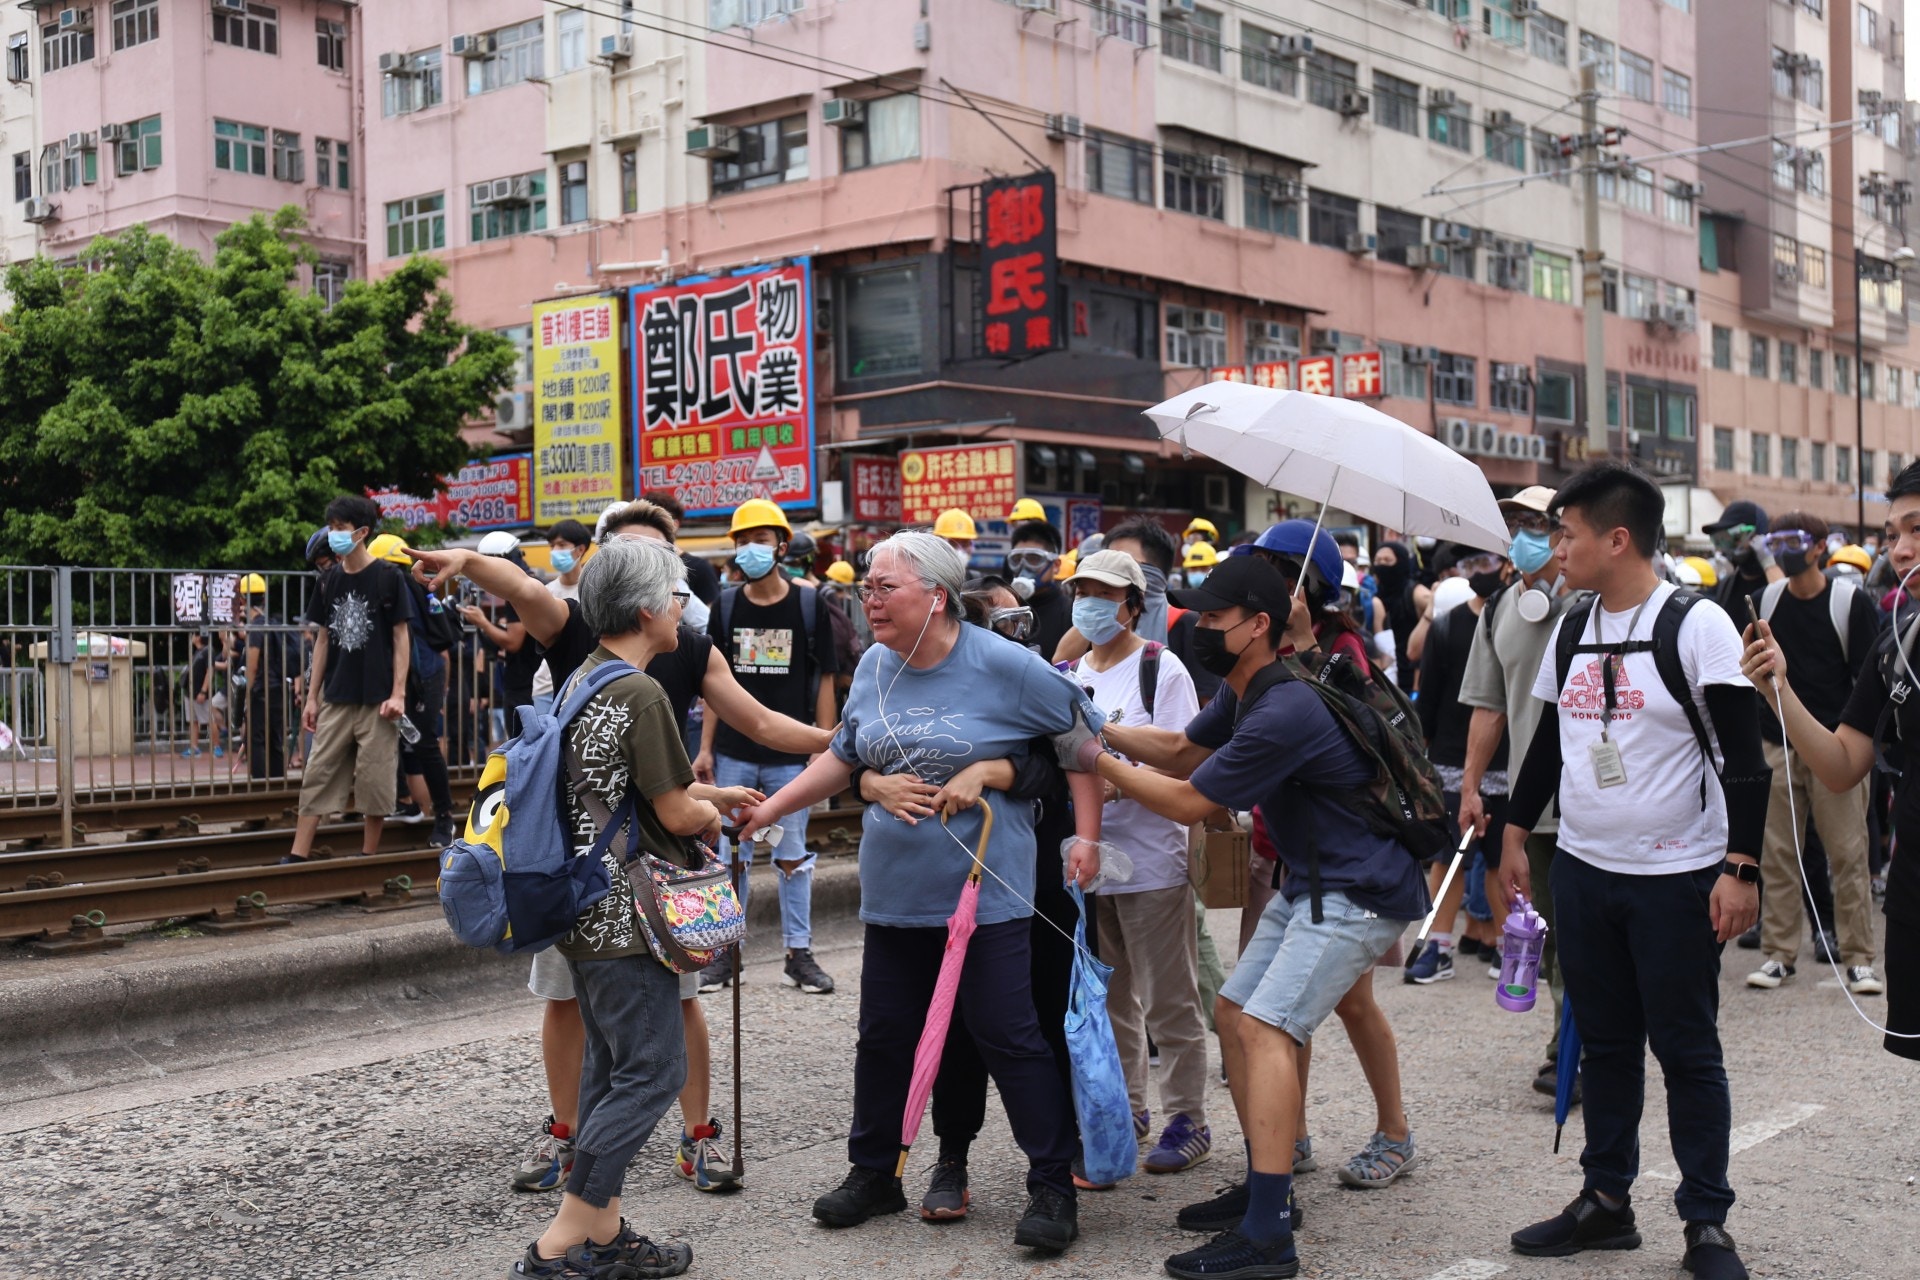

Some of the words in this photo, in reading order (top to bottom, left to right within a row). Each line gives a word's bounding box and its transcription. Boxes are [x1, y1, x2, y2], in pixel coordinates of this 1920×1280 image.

[759, 666, 789, 675] season
[1571, 712, 1600, 720] HONG
[1610, 713, 1632, 721] ONG
